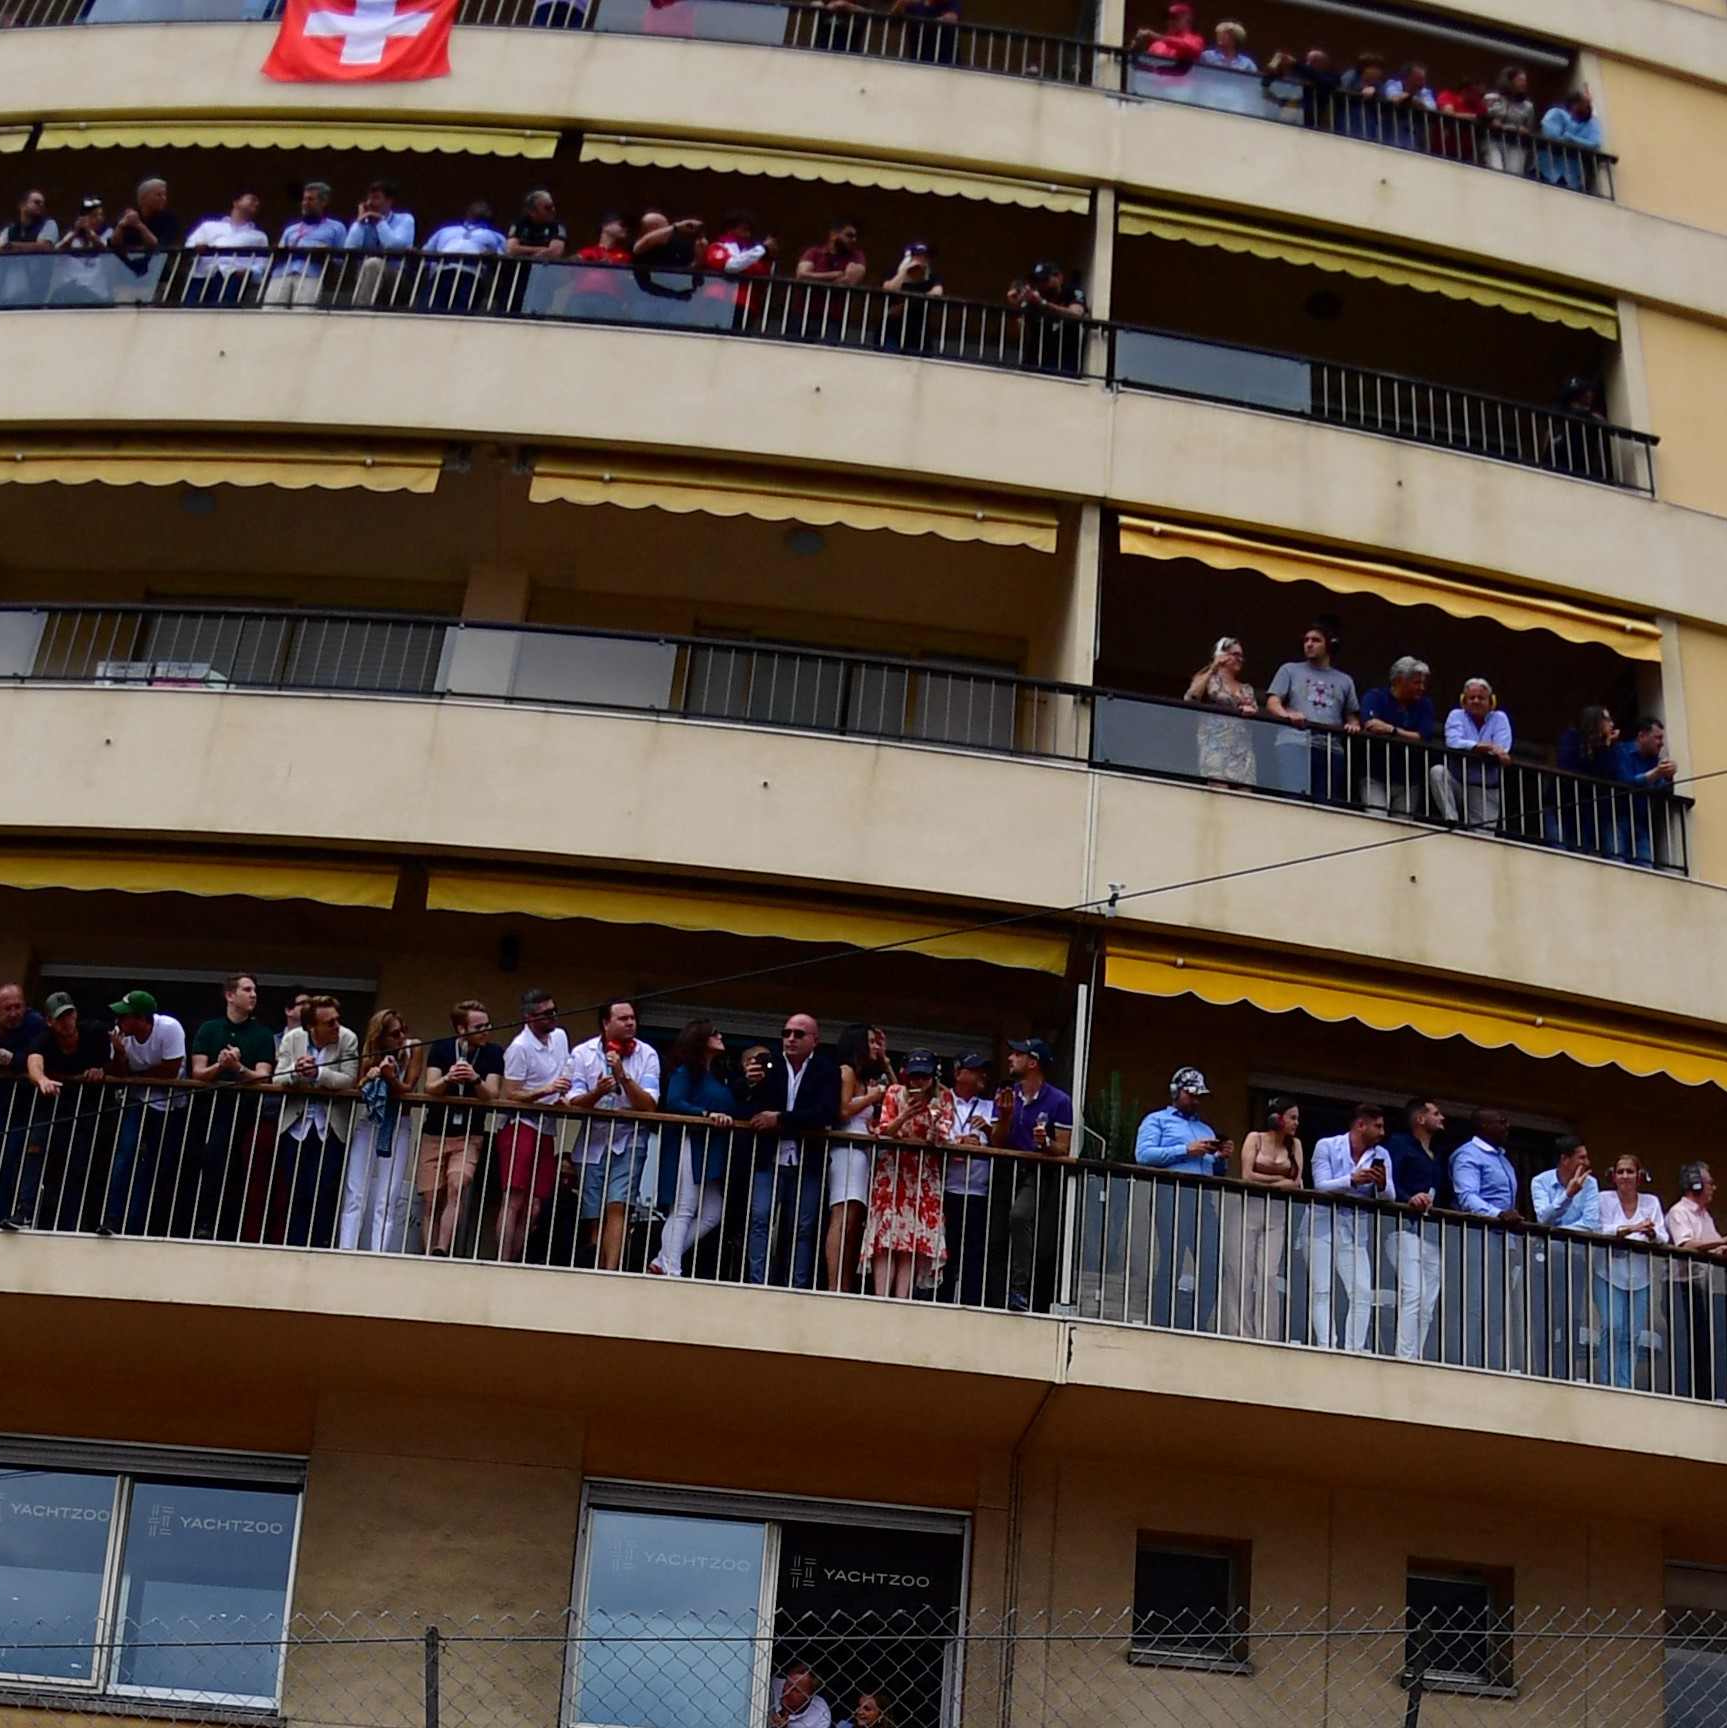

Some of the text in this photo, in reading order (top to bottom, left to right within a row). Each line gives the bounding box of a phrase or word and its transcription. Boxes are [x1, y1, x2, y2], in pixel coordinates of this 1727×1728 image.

[11, 1502, 110, 1523] YACHTZOO
[180, 1516, 284, 1535] YACHTZOO
[645, 1551, 752, 1571] YACHTZOO
[823, 1568, 931, 1589] YACHTZOO
